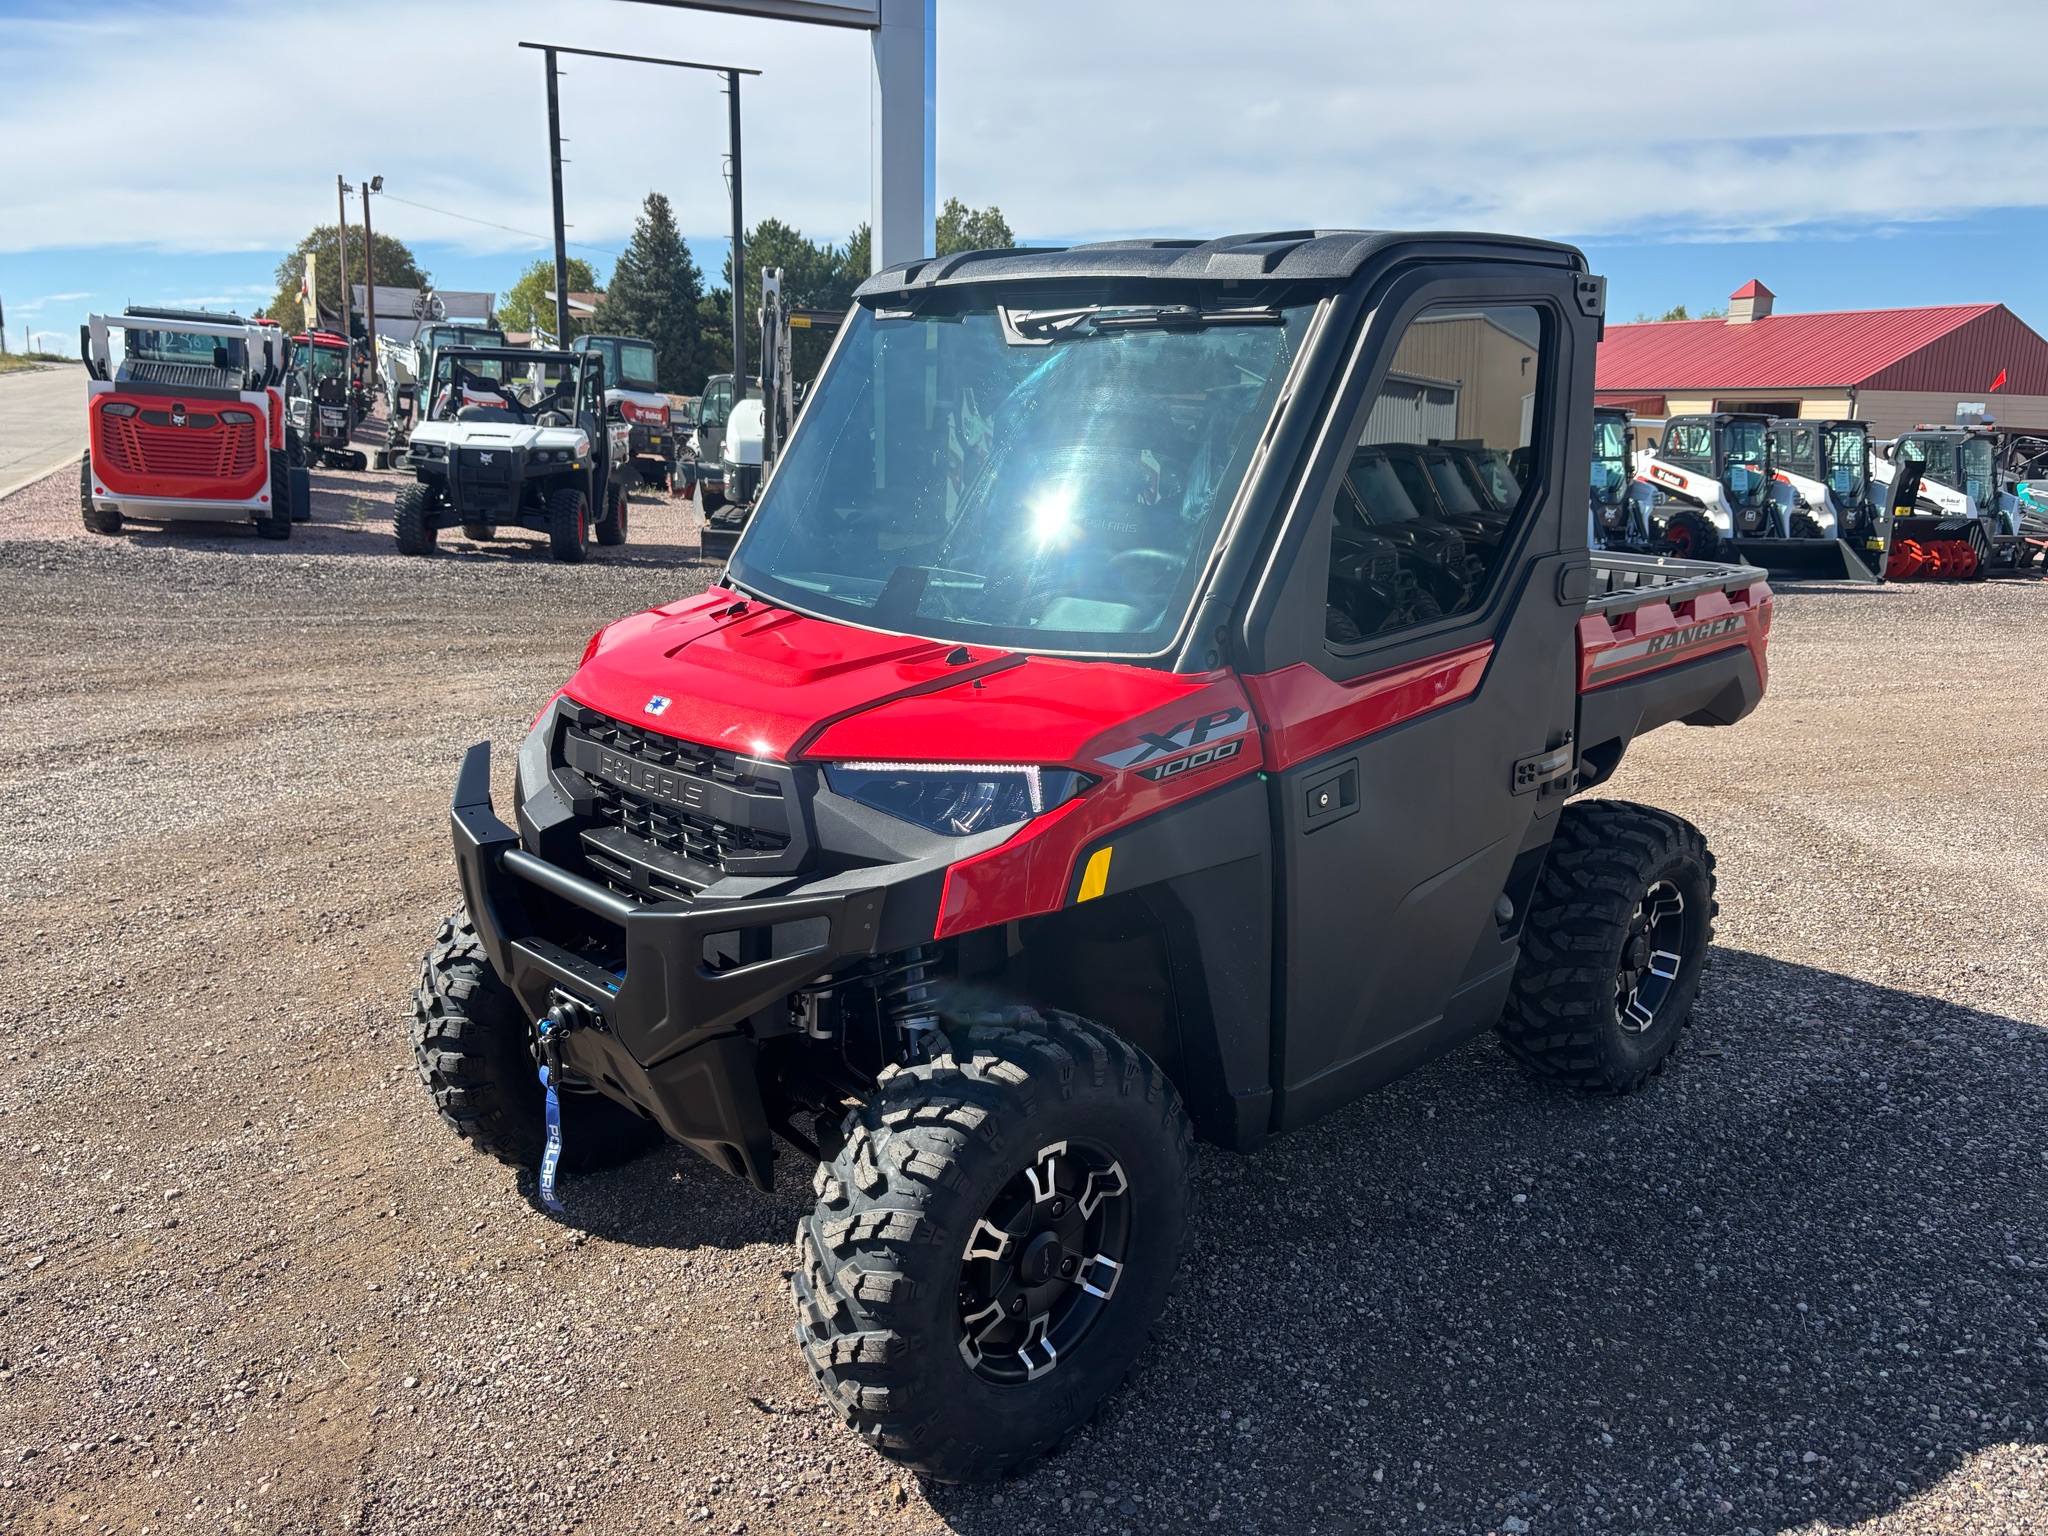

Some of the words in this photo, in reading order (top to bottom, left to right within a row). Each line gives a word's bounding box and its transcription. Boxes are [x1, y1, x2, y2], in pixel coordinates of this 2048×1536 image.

[1646, 615, 1740, 655] RANGER
[1124, 706, 1246, 767] XP
[1154, 741, 1238, 781] 1000
[600, 751, 704, 809] POLARIS
[541, 1124, 562, 1201] POLARIS
